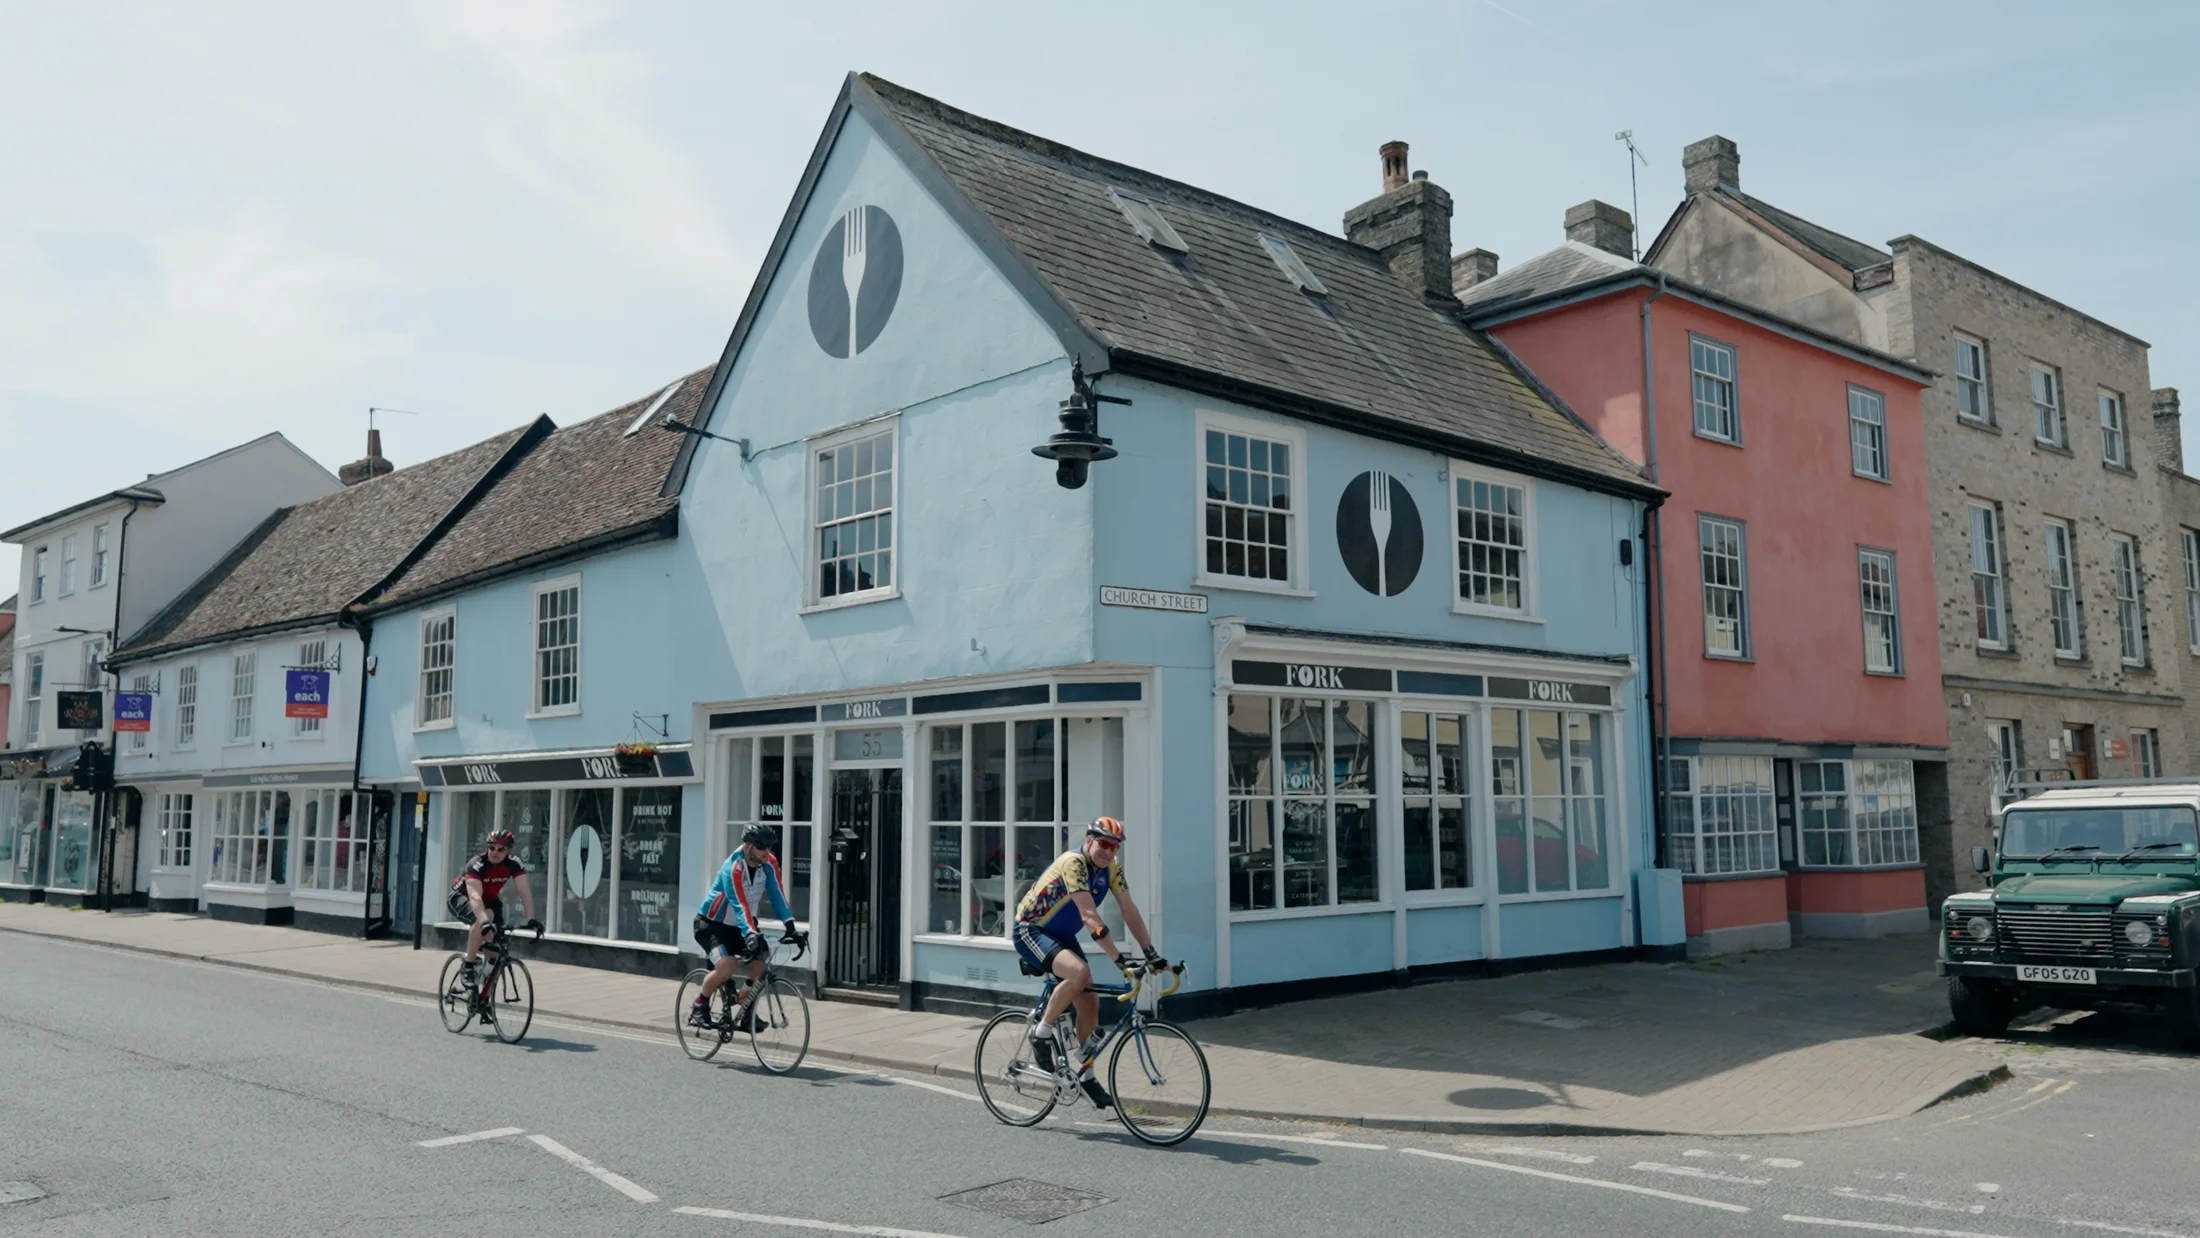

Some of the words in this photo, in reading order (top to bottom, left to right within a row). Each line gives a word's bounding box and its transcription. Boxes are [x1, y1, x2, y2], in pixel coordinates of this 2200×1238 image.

[1104, 589, 1156, 606] CHURCH
[1161, 595, 1204, 610] STREET
[1285, 664, 1344, 689] FORK
[295, 691, 321, 702] each
[1528, 680, 1574, 702] FORK
[121, 710, 144, 719] each
[845, 700, 882, 719] FORK
[862, 731, 882, 757] 55
[464, 763, 502, 784] FORK
[1282, 773, 1323, 790] FORK
[633, 805, 656, 816] DRINK
[657, 805, 672, 816] HOT
[2023, 967, 2059, 980] GF05
[2062, 968, 2090, 981] GZO
